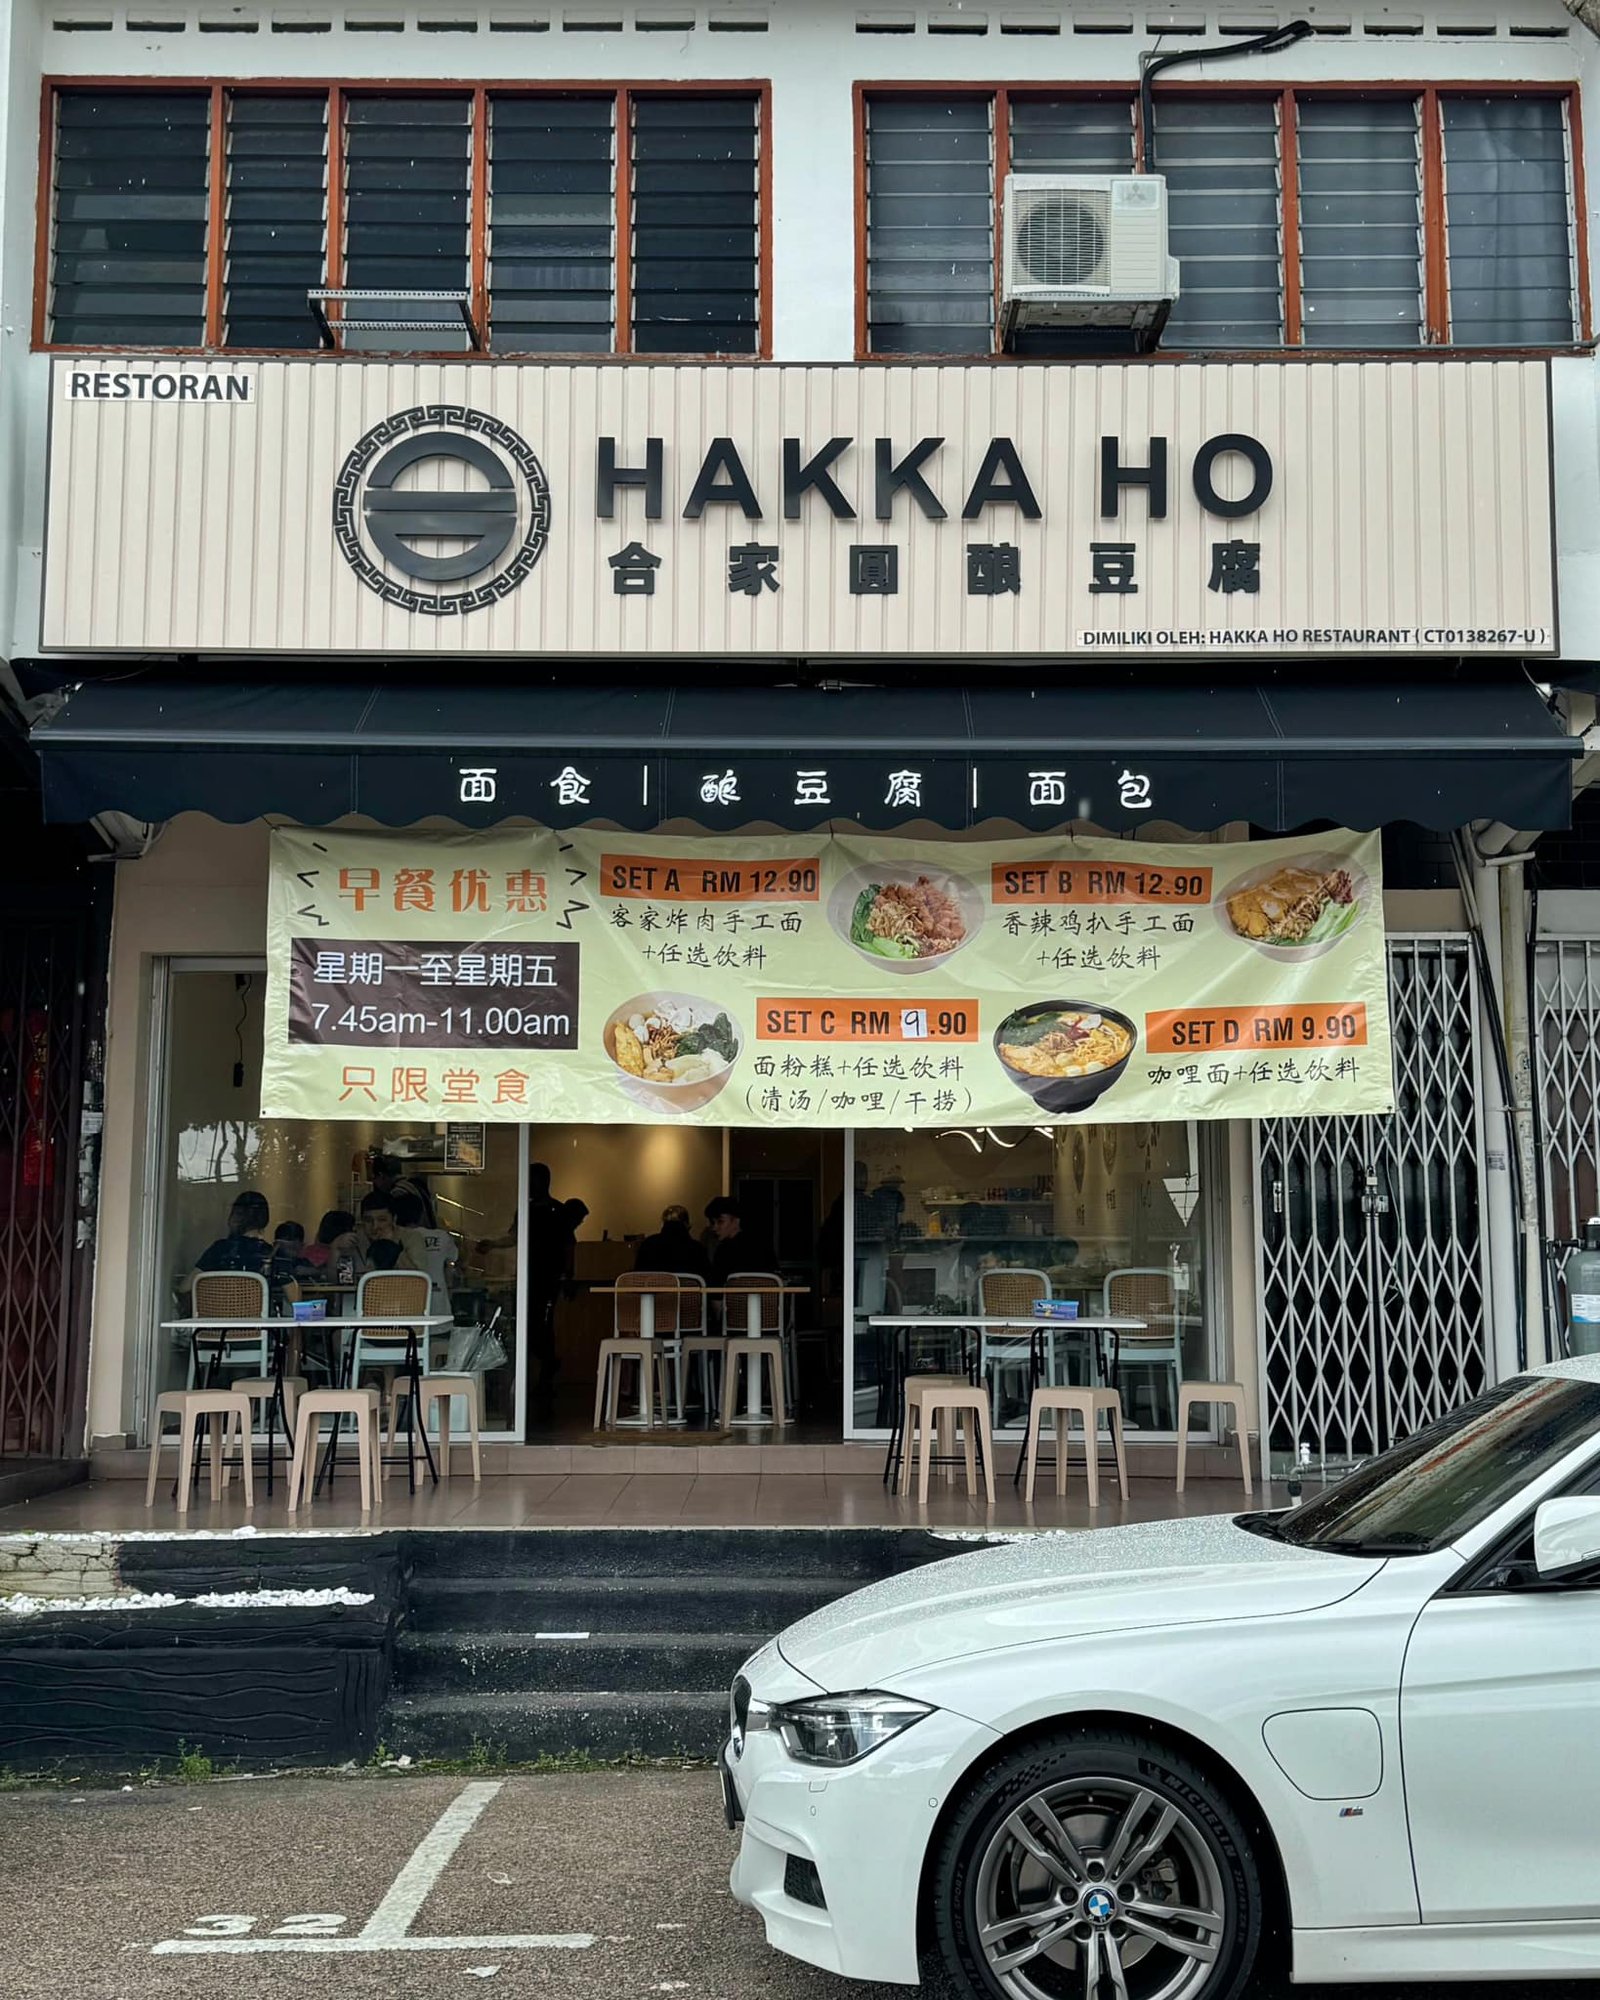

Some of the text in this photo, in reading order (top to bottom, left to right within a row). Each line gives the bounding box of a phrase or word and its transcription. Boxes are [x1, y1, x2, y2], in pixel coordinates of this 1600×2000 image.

[70, 373, 250, 402] RESTORAN
[597, 434, 1274, 519] HAKKA HO
[1083, 631, 1152, 645] DIMILIKI
[1156, 631, 1206, 645] OLEH:
[1209, 630, 1268, 645] HAKKA
[1273, 629, 1298, 644] HO
[1303, 629, 1411, 644] RESTAURANT
[459, 766, 592, 806] 面食
[1028, 770, 1152, 809] 面包
[338, 867, 548, 912] 早餐优惠
[613, 865, 816, 893] SET A RM 12.90
[1005, 871, 1203, 897] SET B RM 12.90
[609, 903, 802, 933] 客家炸肉手工面
[1003, 909, 1194, 937] 香辣鸡扒手工面
[313, 951, 557, 987] 星期一至星期五
[311, 1003, 570, 1036] 7.45am-11.00am
[767, 1009, 967, 1038] SET C RM 9.90
[1172, 1015, 1356, 1045] SET D RM 9.90
[338, 1066, 530, 1104] 只限堂食
[1164, 1774, 1237, 1858] MICHELIN
[182, 1913, 347, 1936] 32
